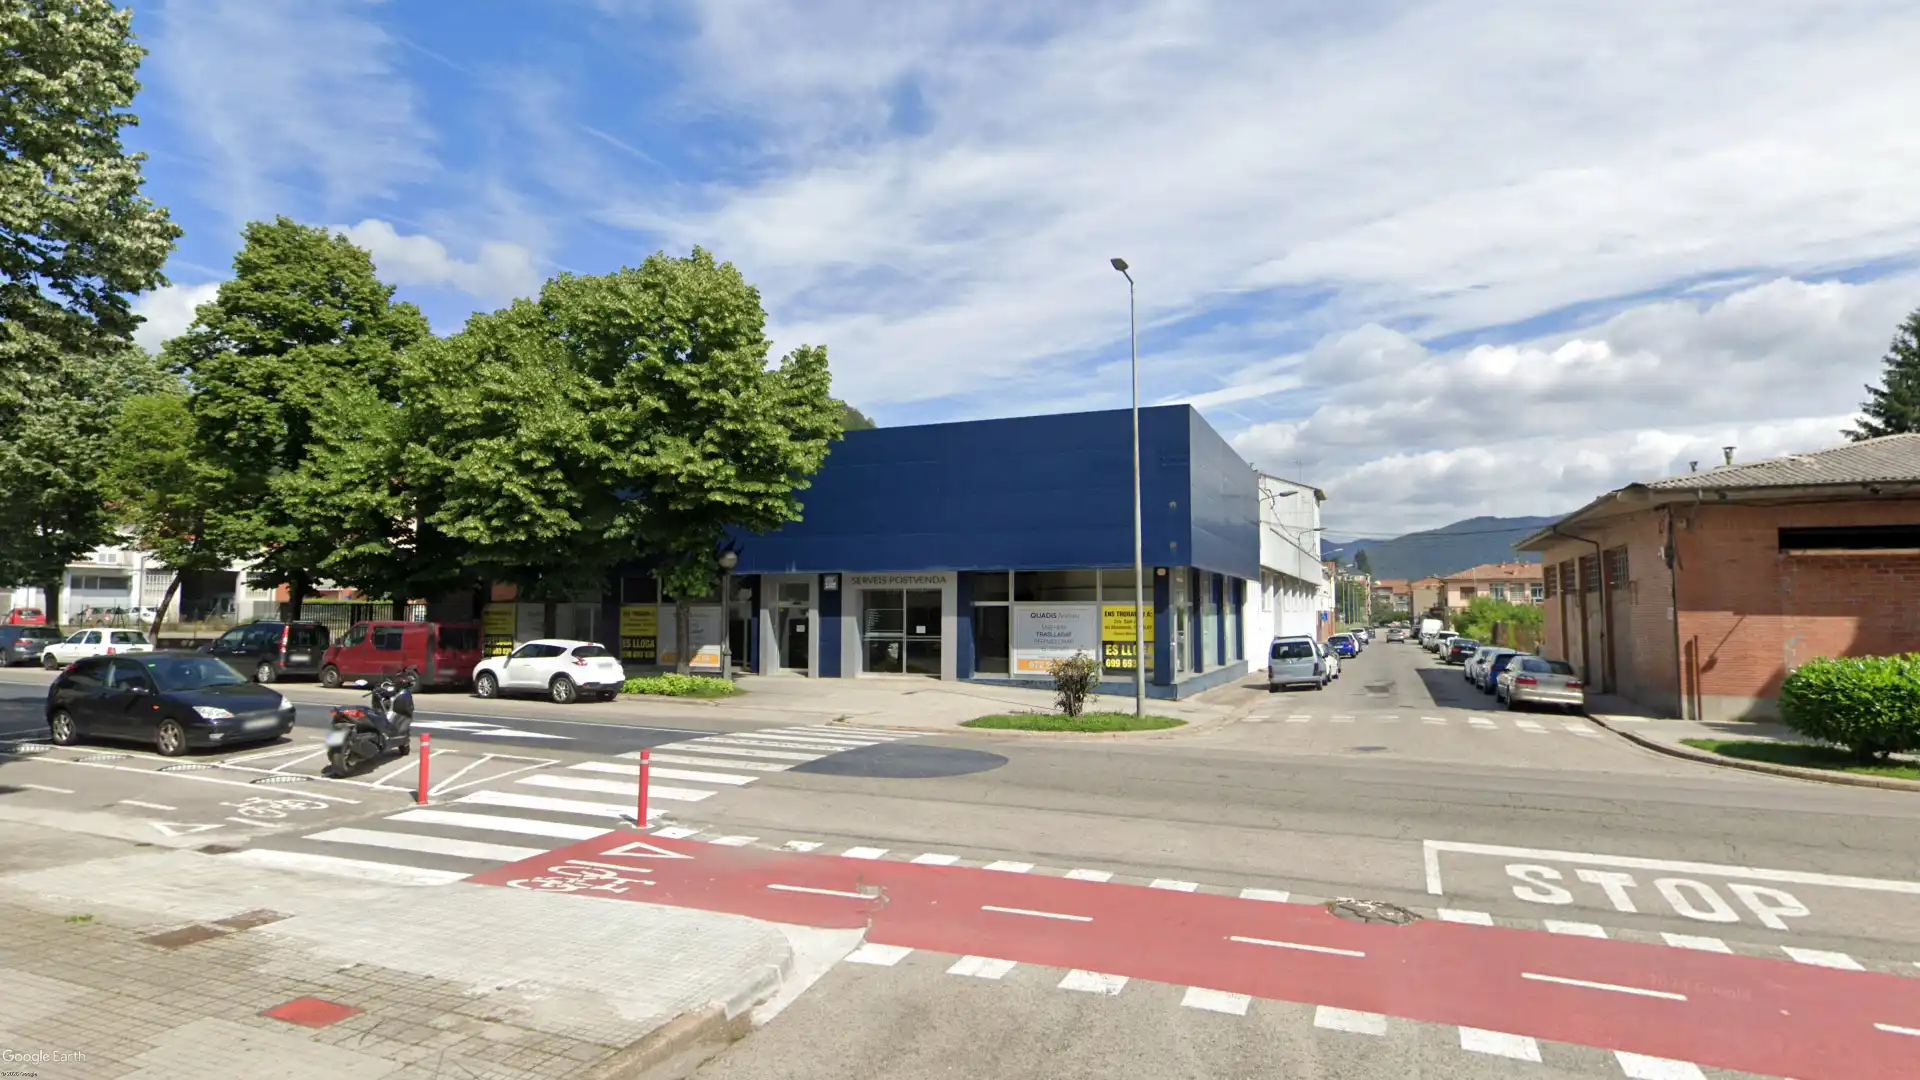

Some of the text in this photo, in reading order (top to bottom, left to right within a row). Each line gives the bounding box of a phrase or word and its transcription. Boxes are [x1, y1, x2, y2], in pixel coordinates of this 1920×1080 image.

[851, 575, 947, 585] SERVEIS POSTVENDA
[1105, 644, 1119, 656] ES
[1105, 658, 1121, 668] 699
[1504, 862, 1811, 931] STOP
